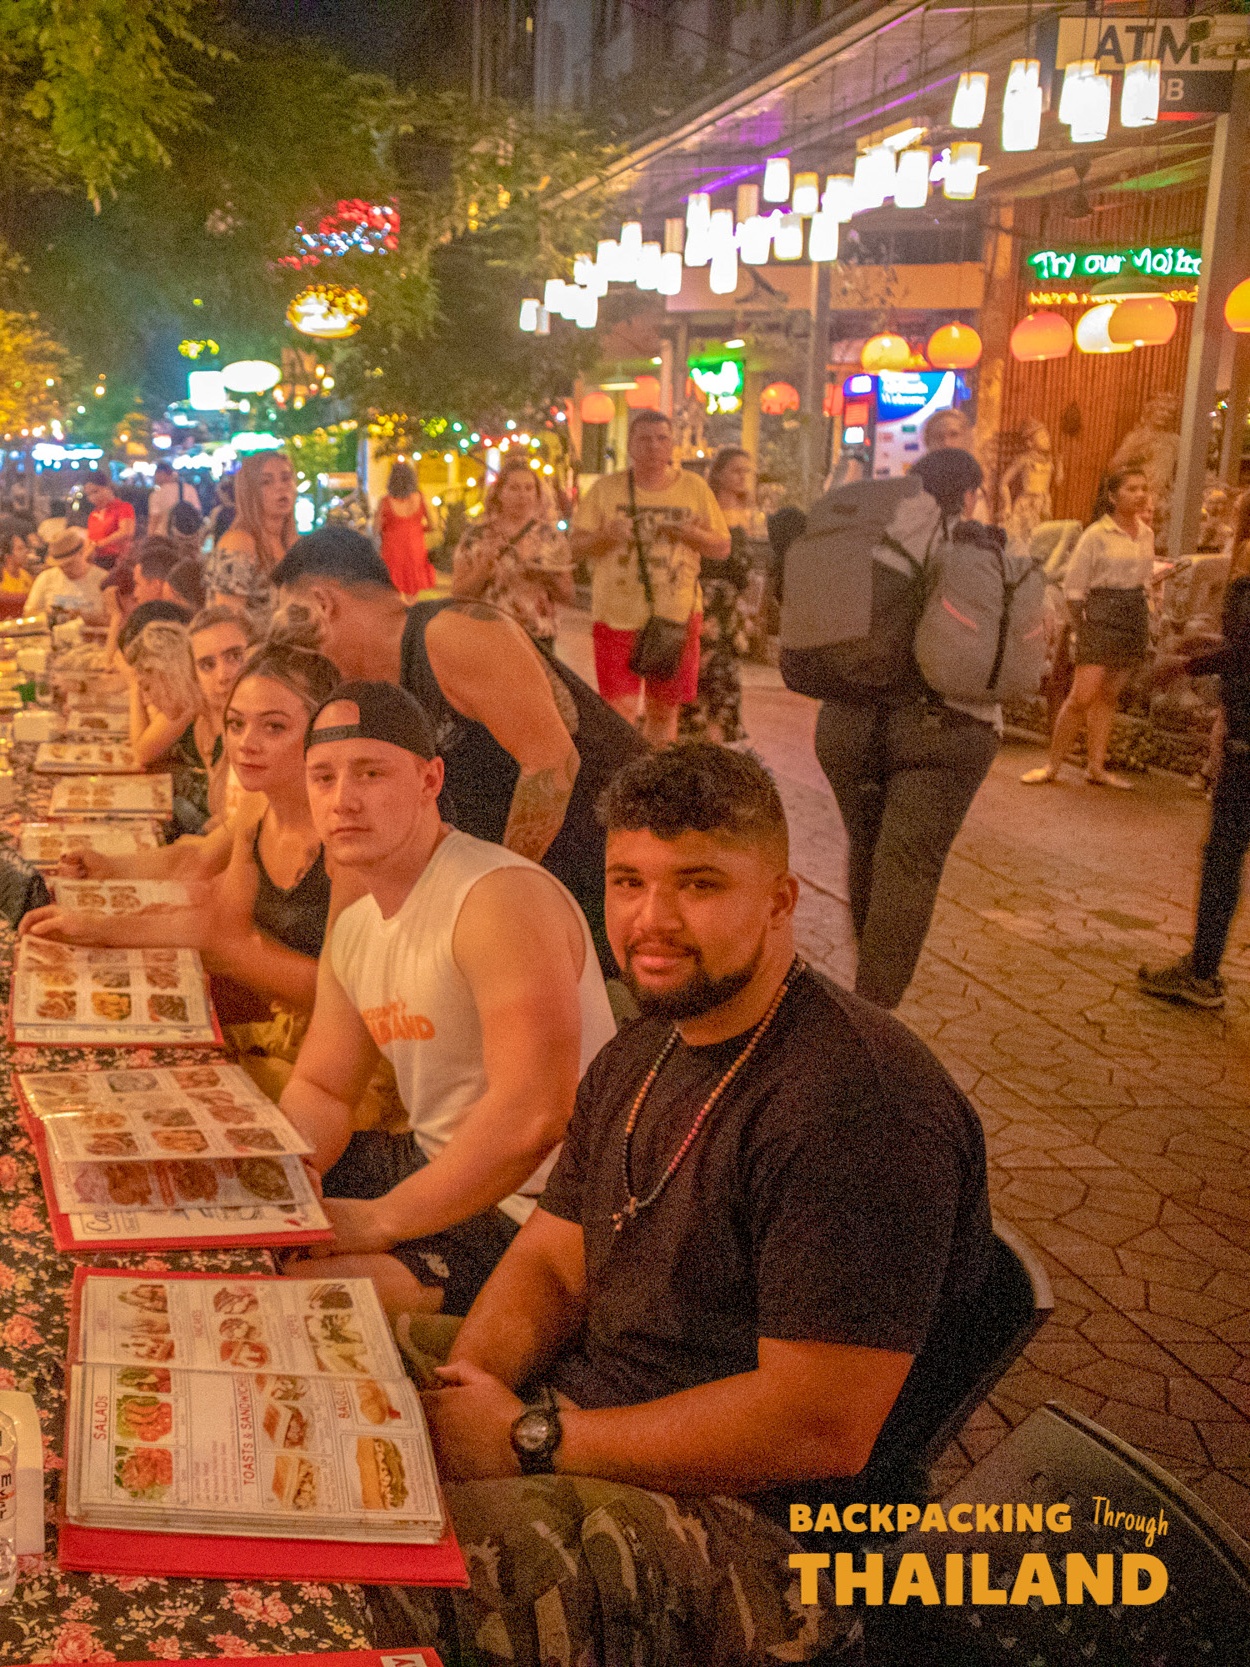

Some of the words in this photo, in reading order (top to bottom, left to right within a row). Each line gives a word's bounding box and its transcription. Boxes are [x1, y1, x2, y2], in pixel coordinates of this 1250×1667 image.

[1095, 25, 1200, 65] ATM
[1033, 251, 1077, 279] Try
[1083, 254, 1127, 274] our
